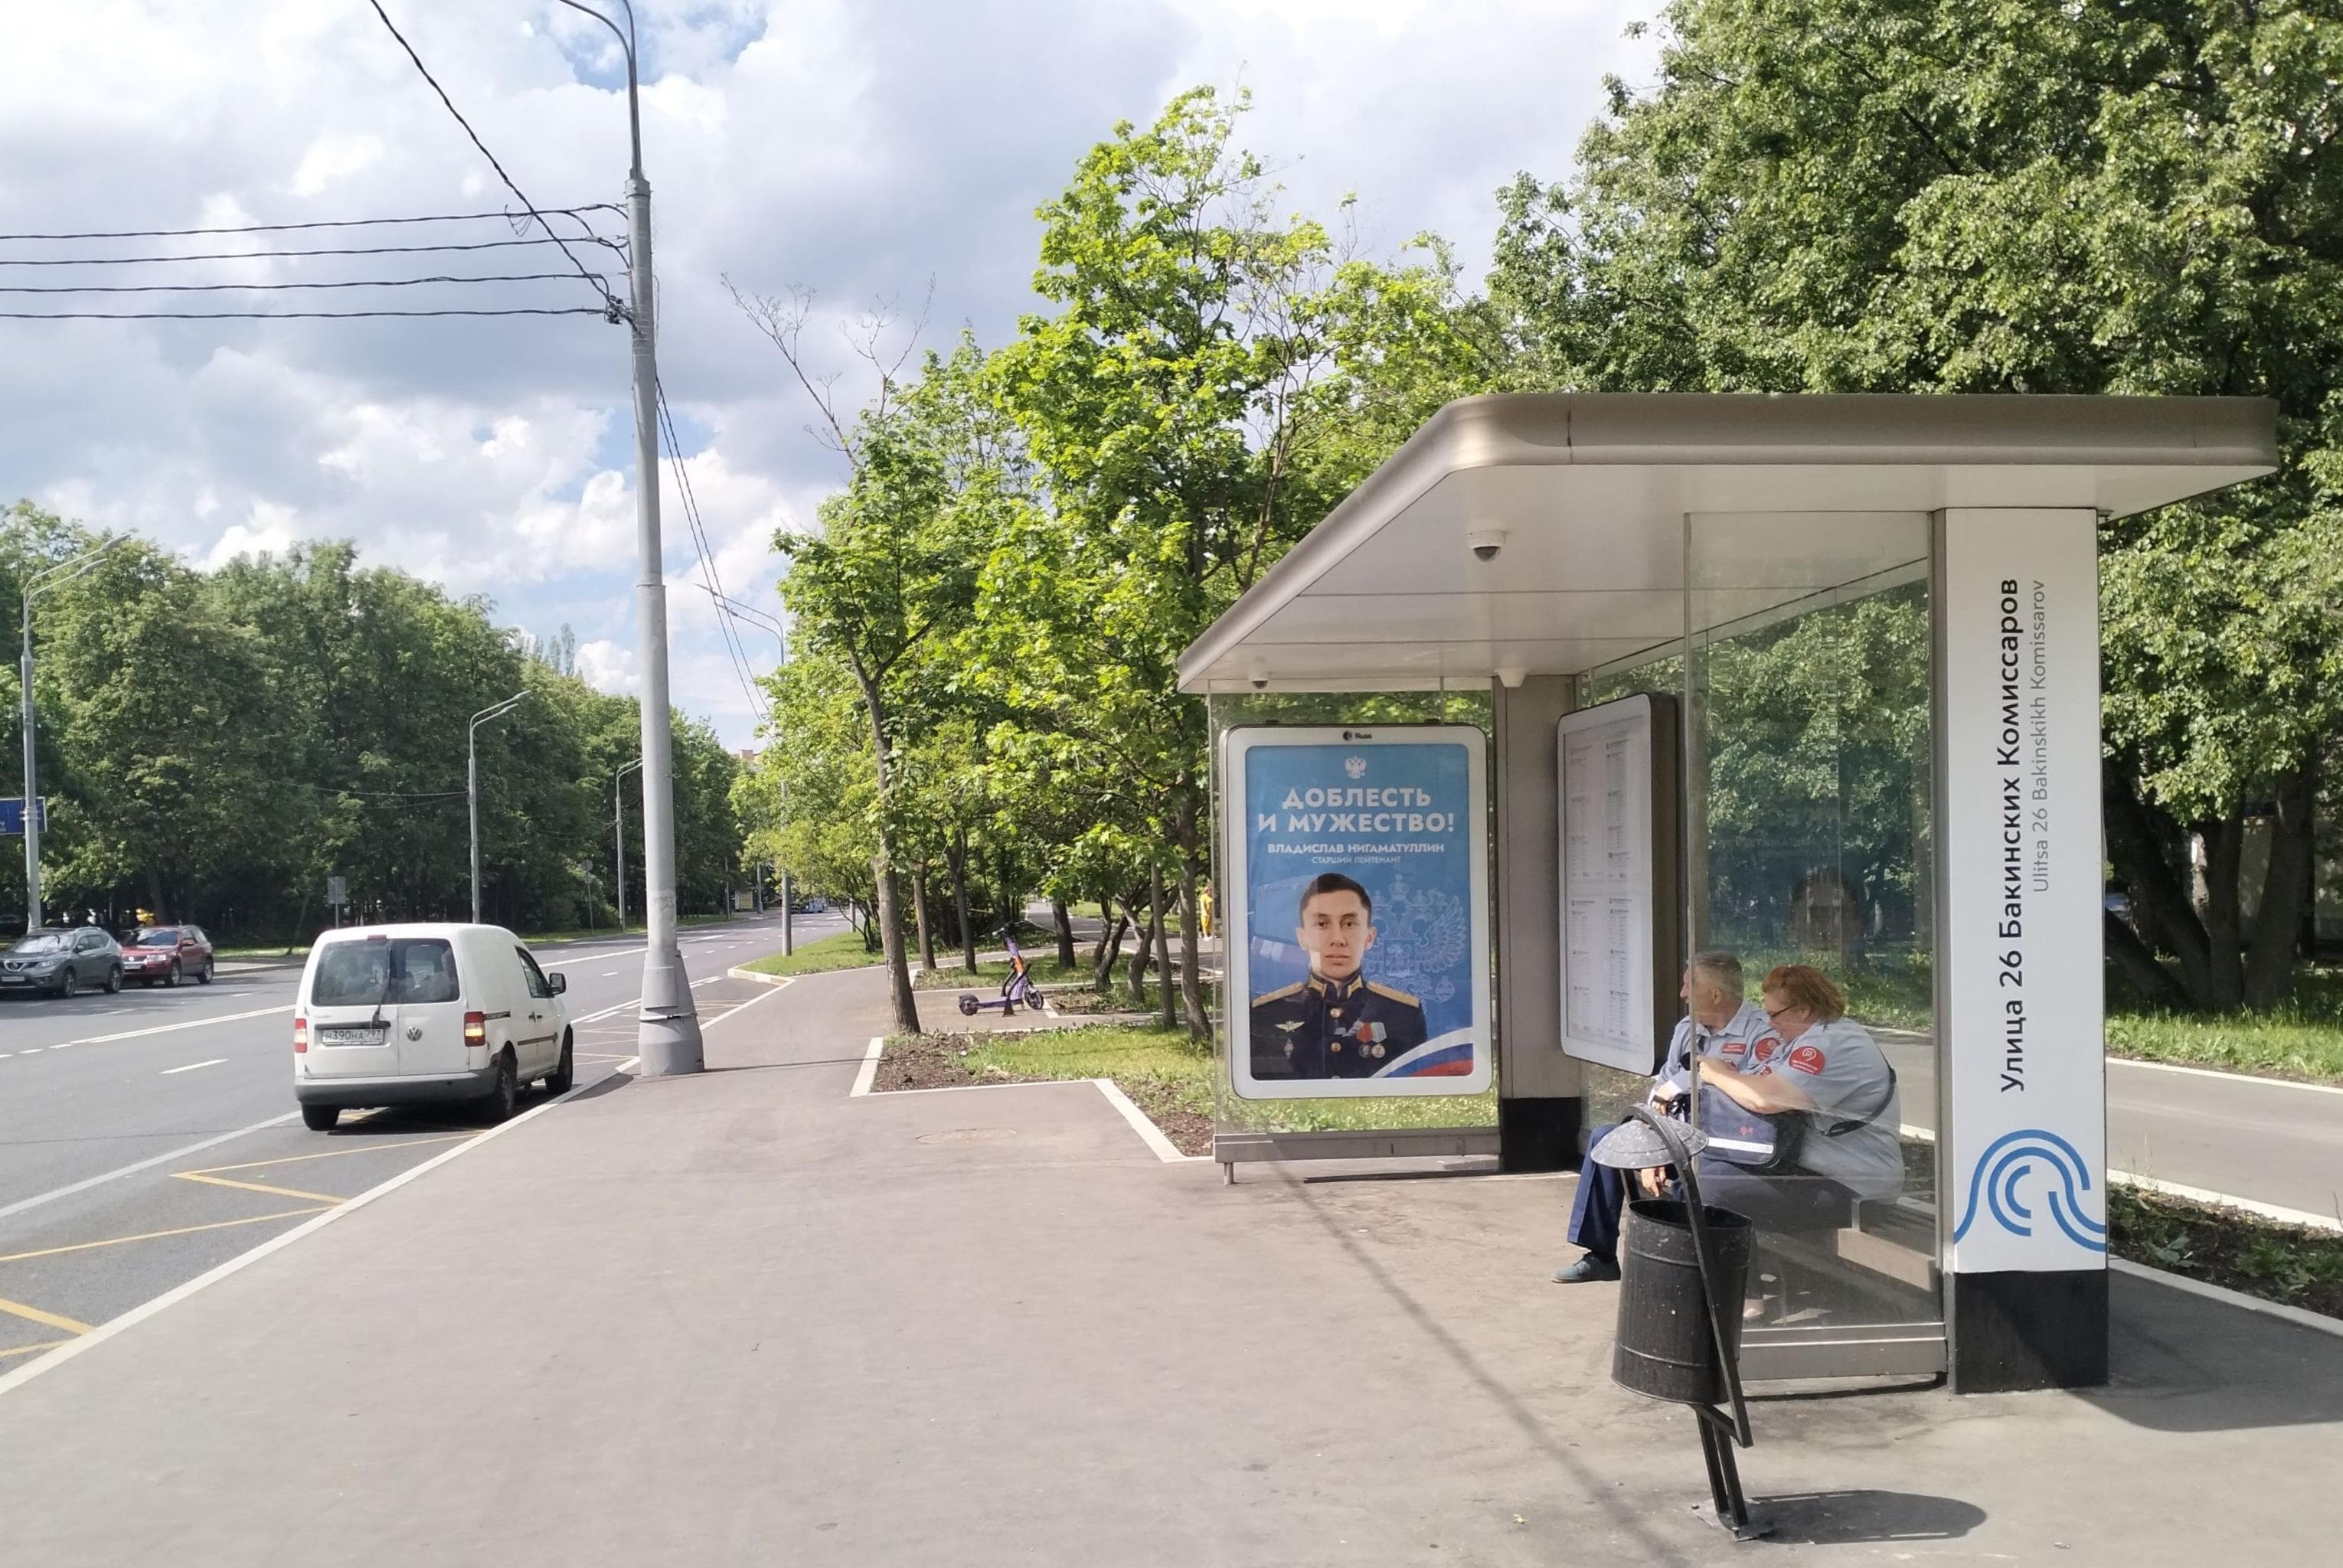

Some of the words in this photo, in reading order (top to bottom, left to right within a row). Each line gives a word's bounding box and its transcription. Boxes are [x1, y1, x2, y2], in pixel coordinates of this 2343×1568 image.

[2030, 580, 2047, 689] Komissarov
[1996, 579, 2024, 766] Комиссаров
[2030, 697, 2047, 800] Bakinskikh
[1282, 787, 1432, 810] ДОБЛЕСТЬ
[2032, 808, 2048, 832] 26
[1258, 814, 1277, 833] И
[1288, 812, 1455, 833] МУЖЕСТВО!
[1267, 843, 1345, 854] ВЛАДИСЛАВ
[1348, 843, 1446, 853] НИГАМАТУЛЛИН
[1312, 855, 1351, 864] СТАРШИЙ
[1998, 777, 2022, 939] Бакинских
[2033, 840, 2049, 893] Ulitsa
[1998, 950, 2023, 988] 26
[2000, 1000, 2026, 1093] Улица
